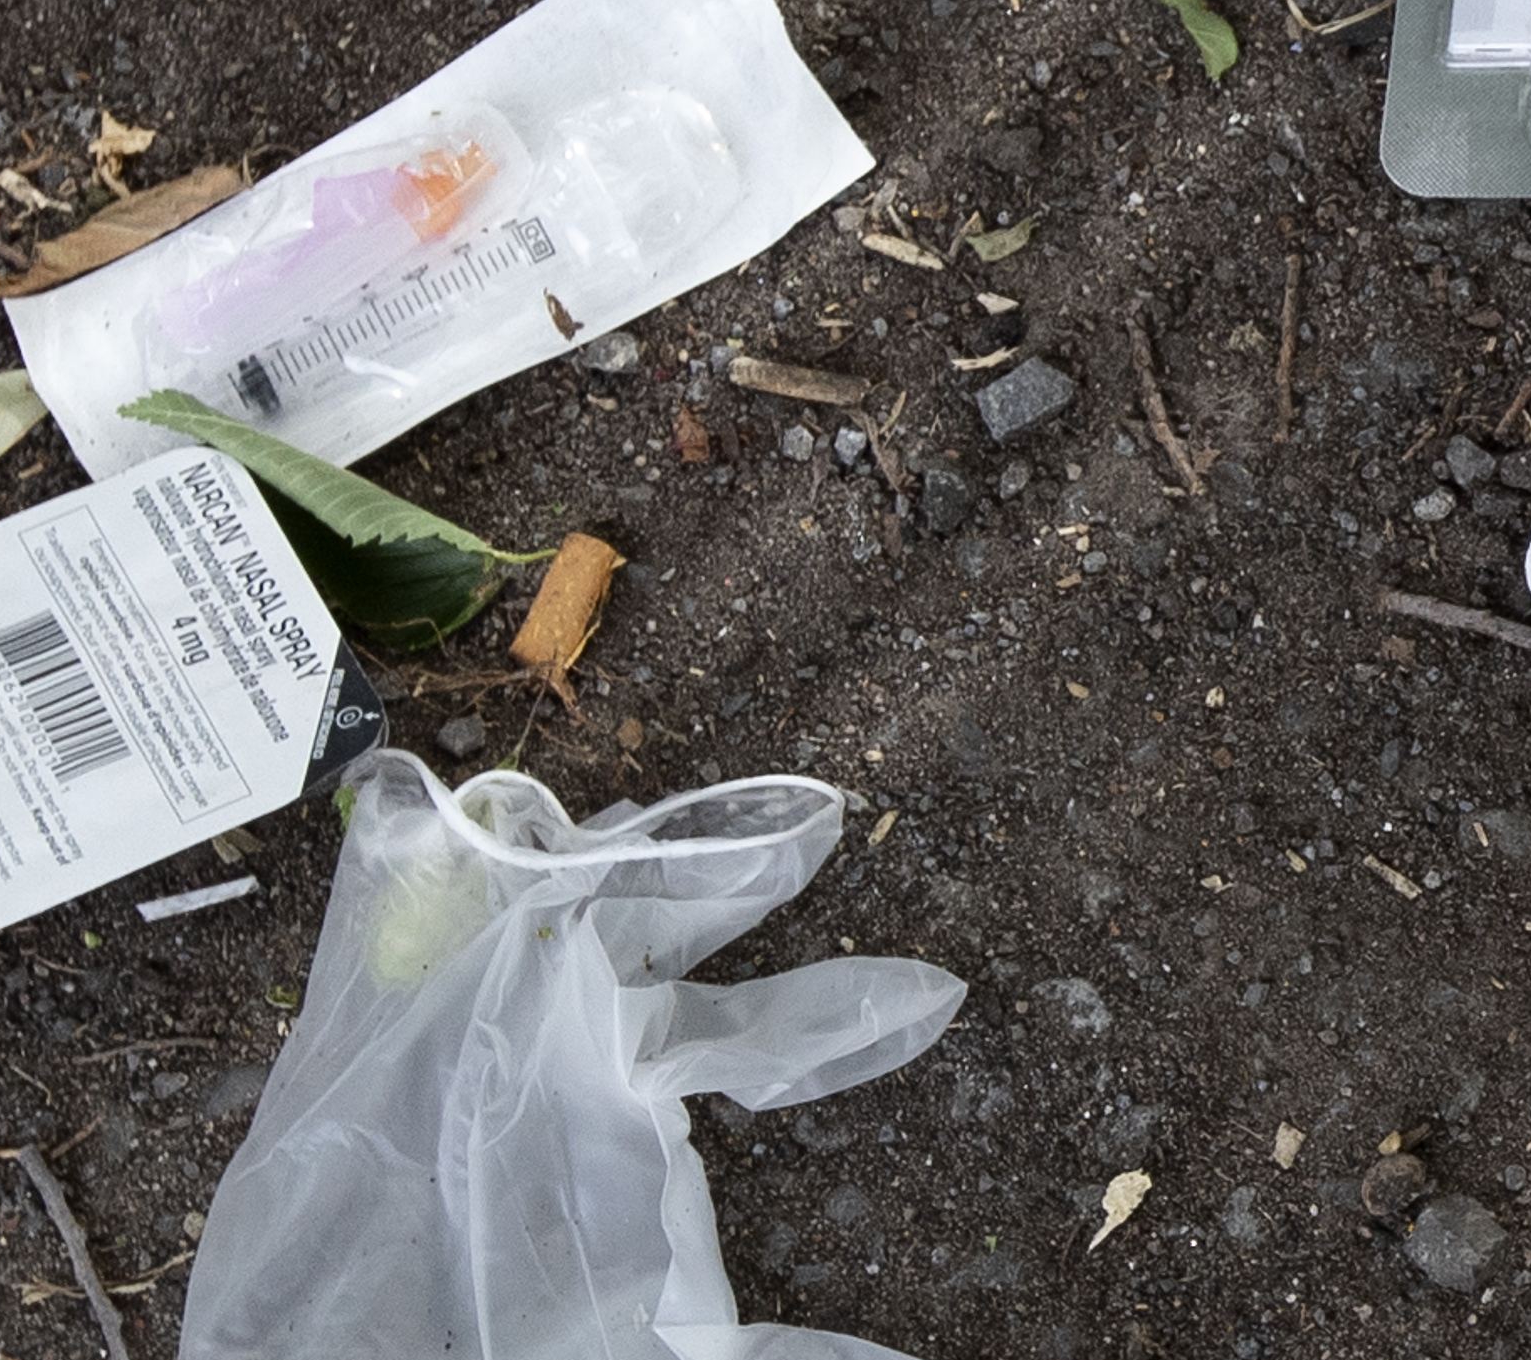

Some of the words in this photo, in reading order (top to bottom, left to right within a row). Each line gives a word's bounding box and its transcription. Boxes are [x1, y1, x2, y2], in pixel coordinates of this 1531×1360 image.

[133, 486, 182, 555] vaporisateur
[156, 476, 196, 529] naloxone
[186, 525, 242, 607] hydrochloride
[224, 605, 264, 637] nasal
[246, 636, 277, 670] spray
[172, 555, 206, 589] nasal
[189, 587, 212, 604] de
[231, 551, 286, 622] NASAL
[269, 617, 325, 680] SPRAY
[172, 616, 198, 630] 4
[198, 603, 250, 675] chlorhydrate
[178, 630, 210, 666] mg
[239, 673, 262, 691] de
[249, 689, 289, 743] naloxone
